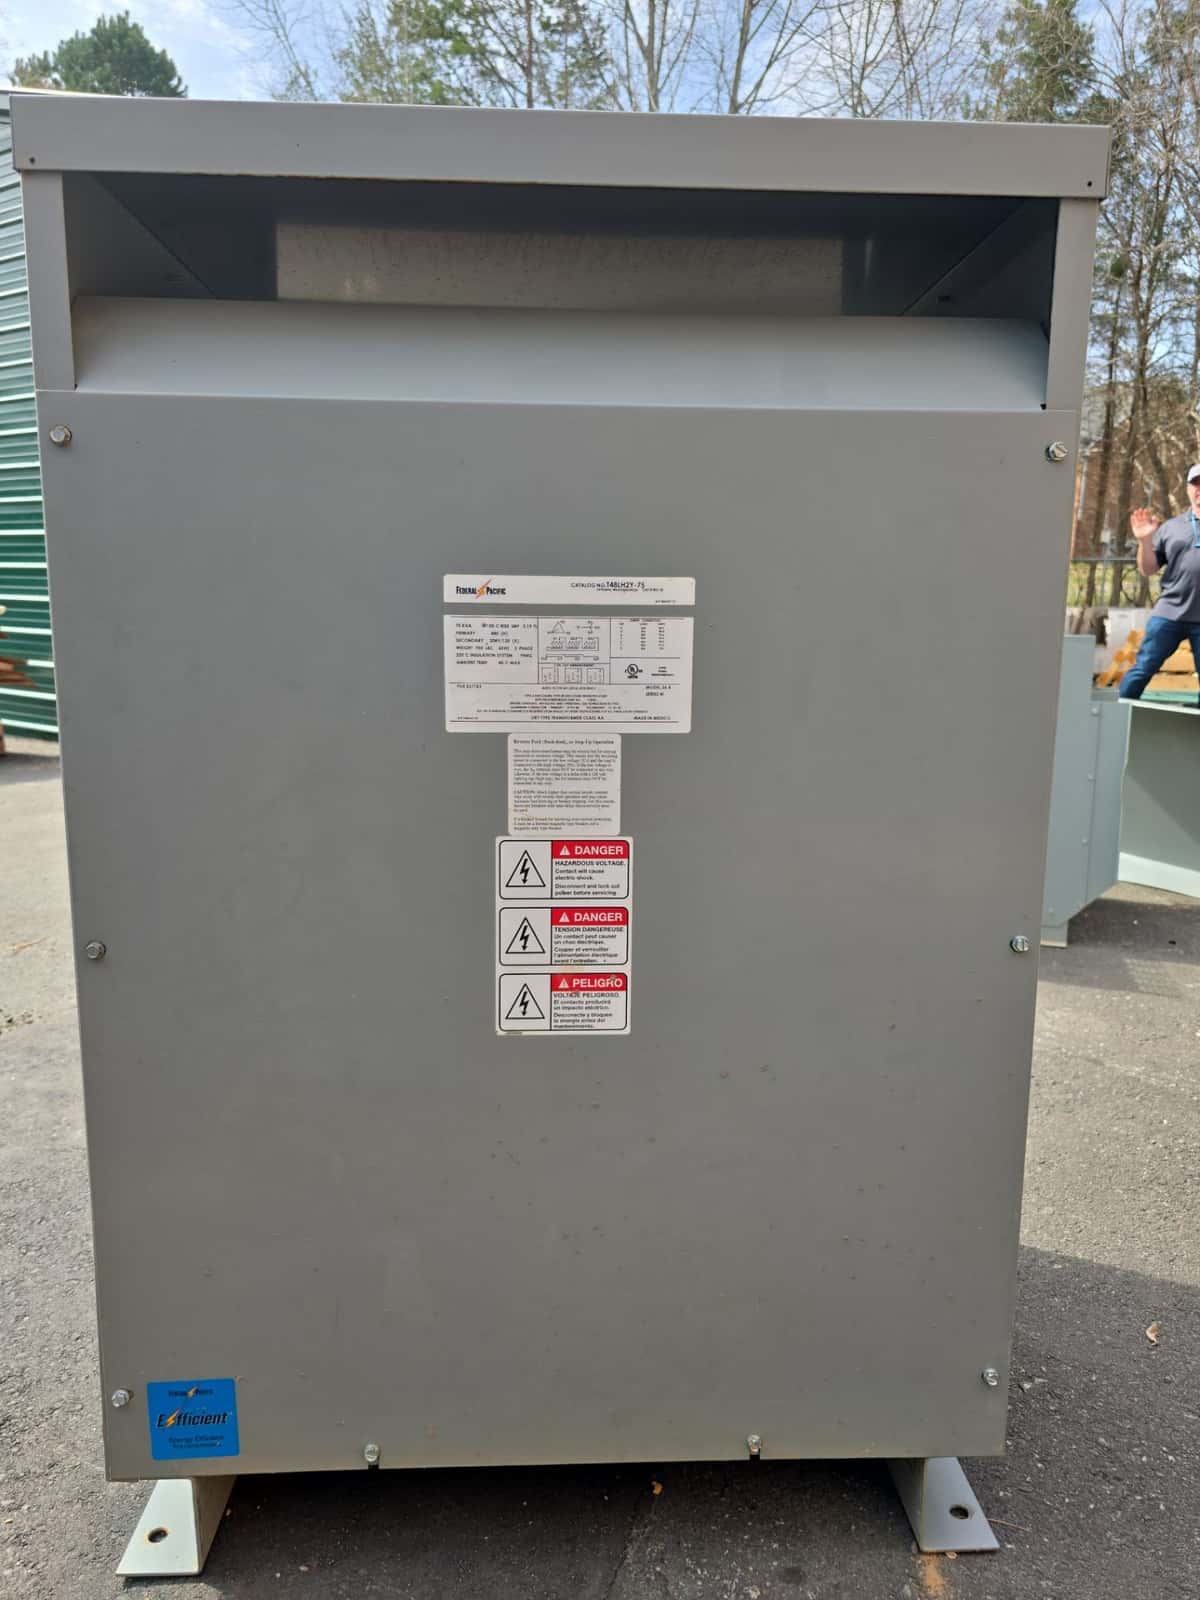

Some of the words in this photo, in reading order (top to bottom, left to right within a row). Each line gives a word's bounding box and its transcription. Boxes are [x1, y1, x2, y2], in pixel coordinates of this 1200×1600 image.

[456, 586, 477, 595] FEDERAL
[486, 586, 506, 595] PACIFIC
[575, 845, 623, 855] DANGER
[574, 912, 623, 922] DANGER
[572, 978, 623, 988] PELIGRO
